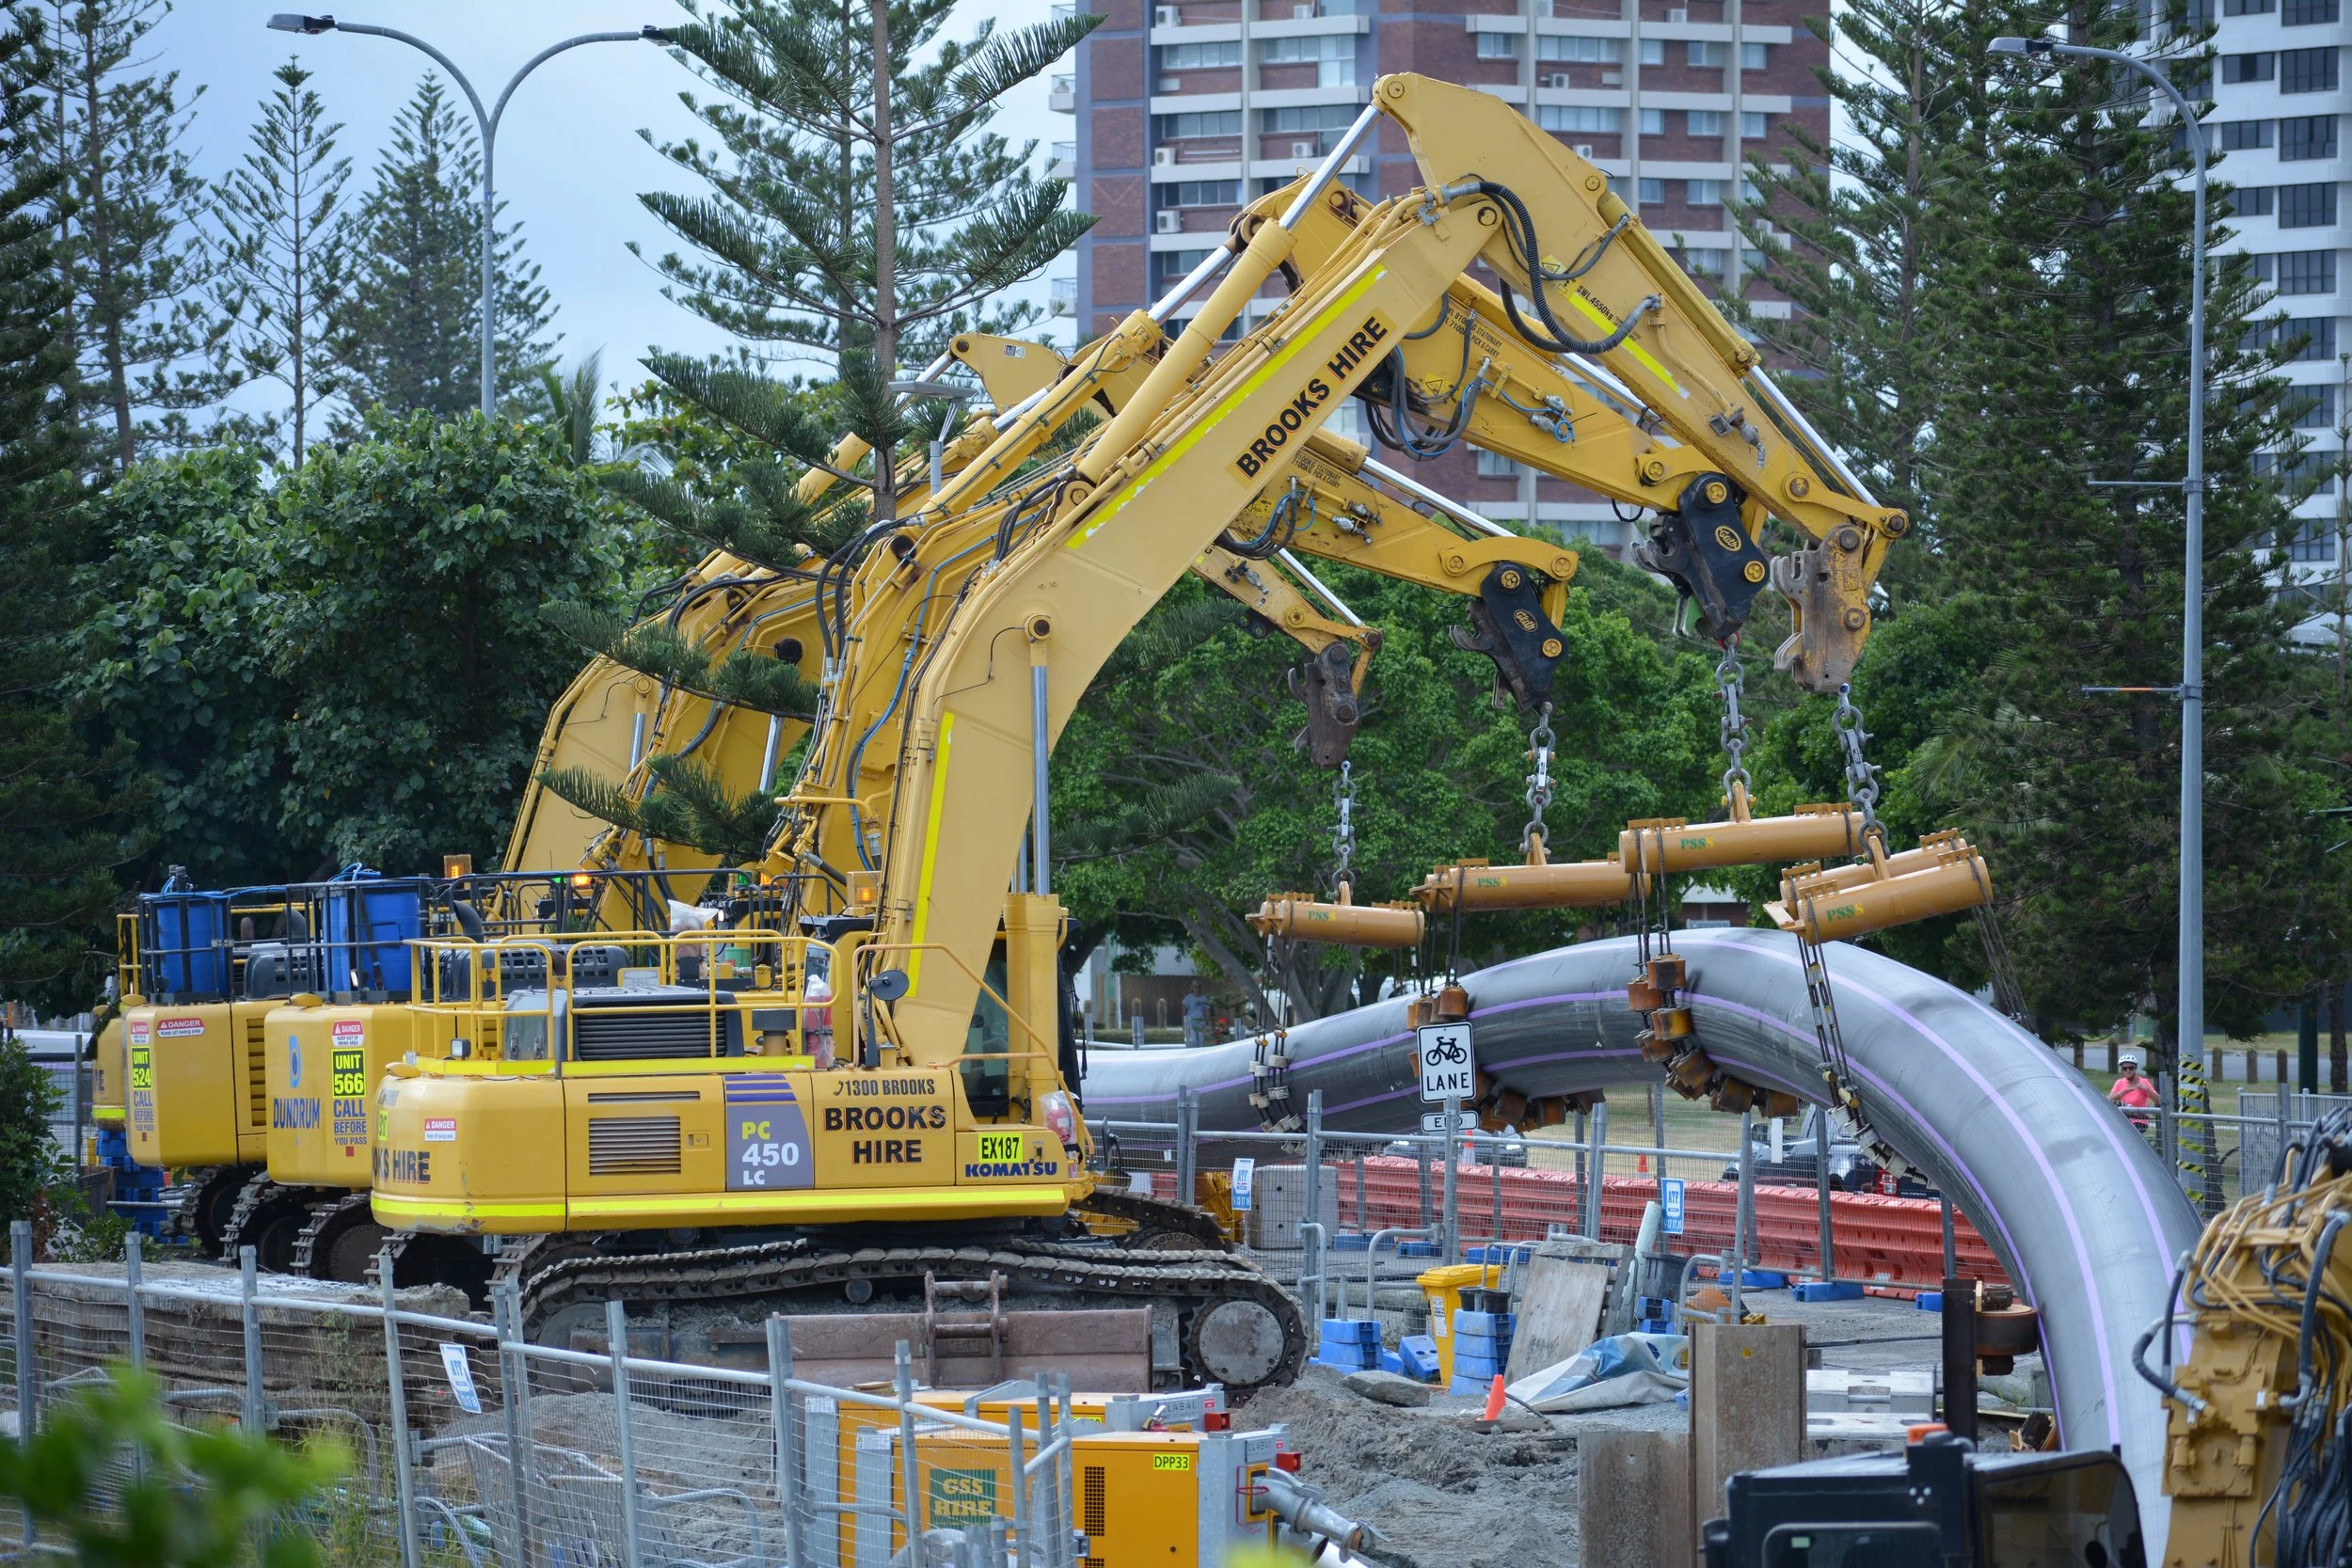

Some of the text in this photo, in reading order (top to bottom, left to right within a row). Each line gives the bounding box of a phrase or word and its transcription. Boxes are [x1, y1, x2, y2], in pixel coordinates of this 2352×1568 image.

[636, 285, 674, 322] SWL 4550kg
[1471, 335, 1482, 346] PICK
[1485, 345, 1500, 357] CARRY
[1476, 327, 1502, 348] STATIONARY
[1235, 316, 1388, 480] BROOKS HIRE
[1679, 836, 1714, 850] PSSS
[1478, 877, 1507, 888] PSSS
[1309, 910, 1335, 921] PSSS
[1826, 903, 1864, 921] PSSS
[167, 1020, 200, 1028] DANGER
[133, 1051, 149, 1065] UNIT
[335, 1054, 361, 1069] UNIT
[133, 1068, 151, 1086] 524
[334, 1072, 364, 1094] 566
[1426, 1072, 1470, 1092] LANE
[845, 1079, 935, 1096] 1300 BROOKS
[134, 1091, 152, 1107] CALL
[135, 1110, 153, 1121] BEFORE
[273, 1098, 321, 1129] DUNDRUM
[333, 1100, 366, 1118] CALL
[334, 1121, 367, 1133] BEFORE
[822, 1105, 946, 1132] BROOKS
[1434, 1117, 1463, 1128] ED
[742, 1121, 771, 1140] PC
[334, 1136, 368, 1145] YOU PASS
[981, 1137, 1019, 1159] EX187
[742, 1143, 799, 1166] 450
[852, 1139, 921, 1164] HIRE
[392, 1149, 431, 1184] HIRE
[965, 1159, 1057, 1178] KOMATSU
[743, 1170, 765, 1185] LC
[1237, 1170, 1248, 1181] ATF
[1668, 1190, 1679, 1203] ATF
[451, 1359, 463, 1376] ATF
[1154, 1455, 1188, 1469] DPP33
[934, 1500, 993, 1516] HIRE
